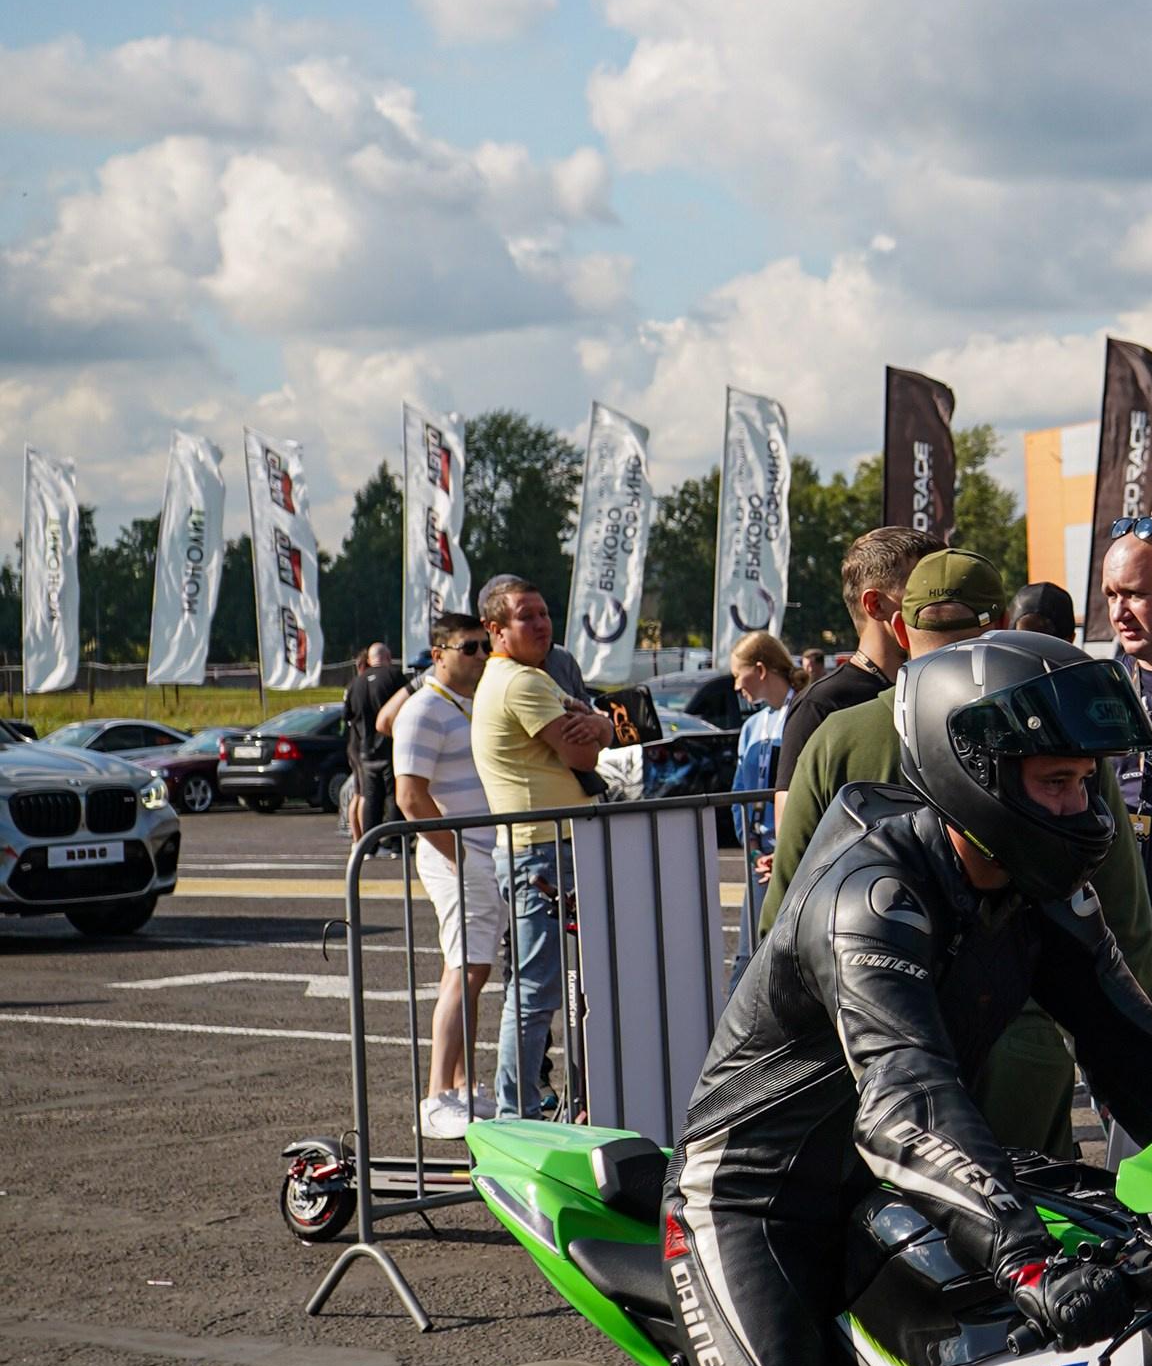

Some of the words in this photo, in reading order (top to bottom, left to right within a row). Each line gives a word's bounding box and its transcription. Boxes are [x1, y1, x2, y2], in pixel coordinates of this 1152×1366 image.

[621, 454, 643, 555] СОФЬИНО
[765, 438, 780, 542] СОФЬИНО
[599, 507, 622, 592] БЫКОВО
[746, 493, 764, 582] БЫКОВО
[928, 587, 962, 597] HUGO
